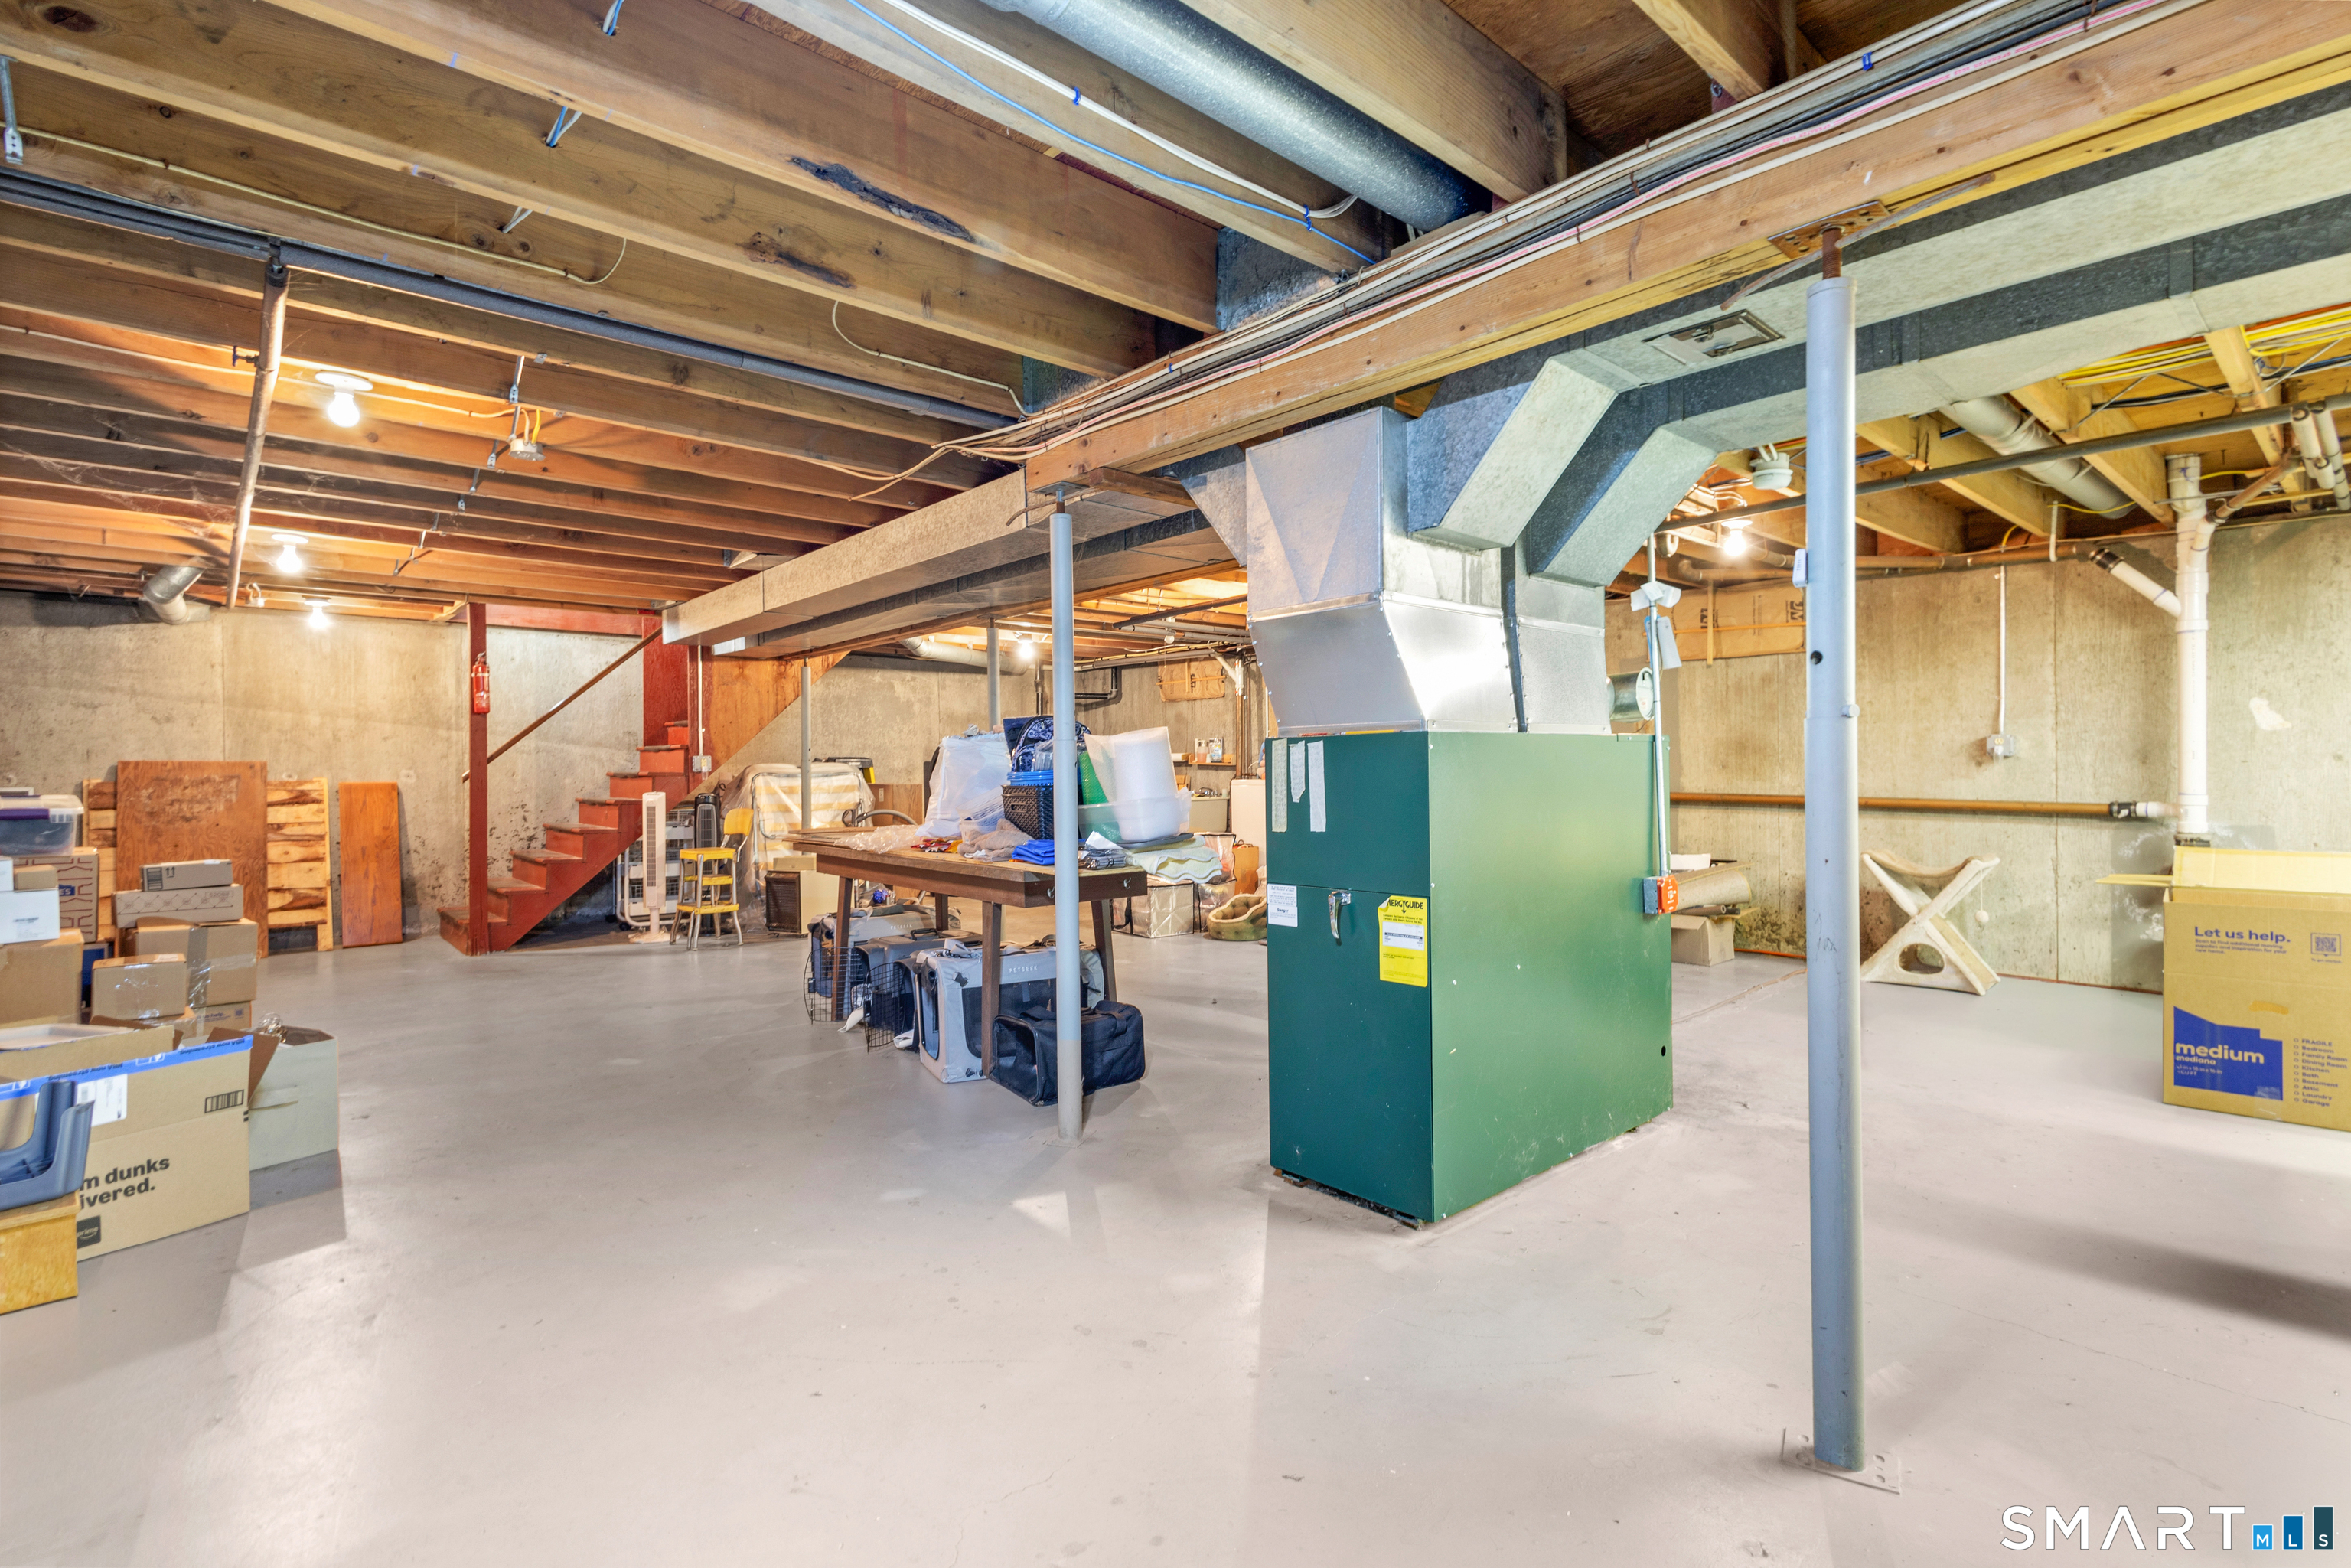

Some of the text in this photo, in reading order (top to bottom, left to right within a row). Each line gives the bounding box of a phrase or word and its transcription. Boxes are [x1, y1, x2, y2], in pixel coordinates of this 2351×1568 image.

[1386, 899, 1423, 910] NERGYGUIDE
[2195, 926, 2291, 944] Let us help.
[2301, 1038, 2333, 1047] FRAGILE
[2176, 1042, 2264, 1064] medium
[2302, 1058, 2325, 1067] Dining
[2302, 1078, 2338, 1087] Basement
[2302, 1092, 2332, 1100] Laundry
[2302, 1098, 2330, 1107] Garage
[105, 1158, 170, 1185] dunks
[77, 1227, 99, 1237] prime
